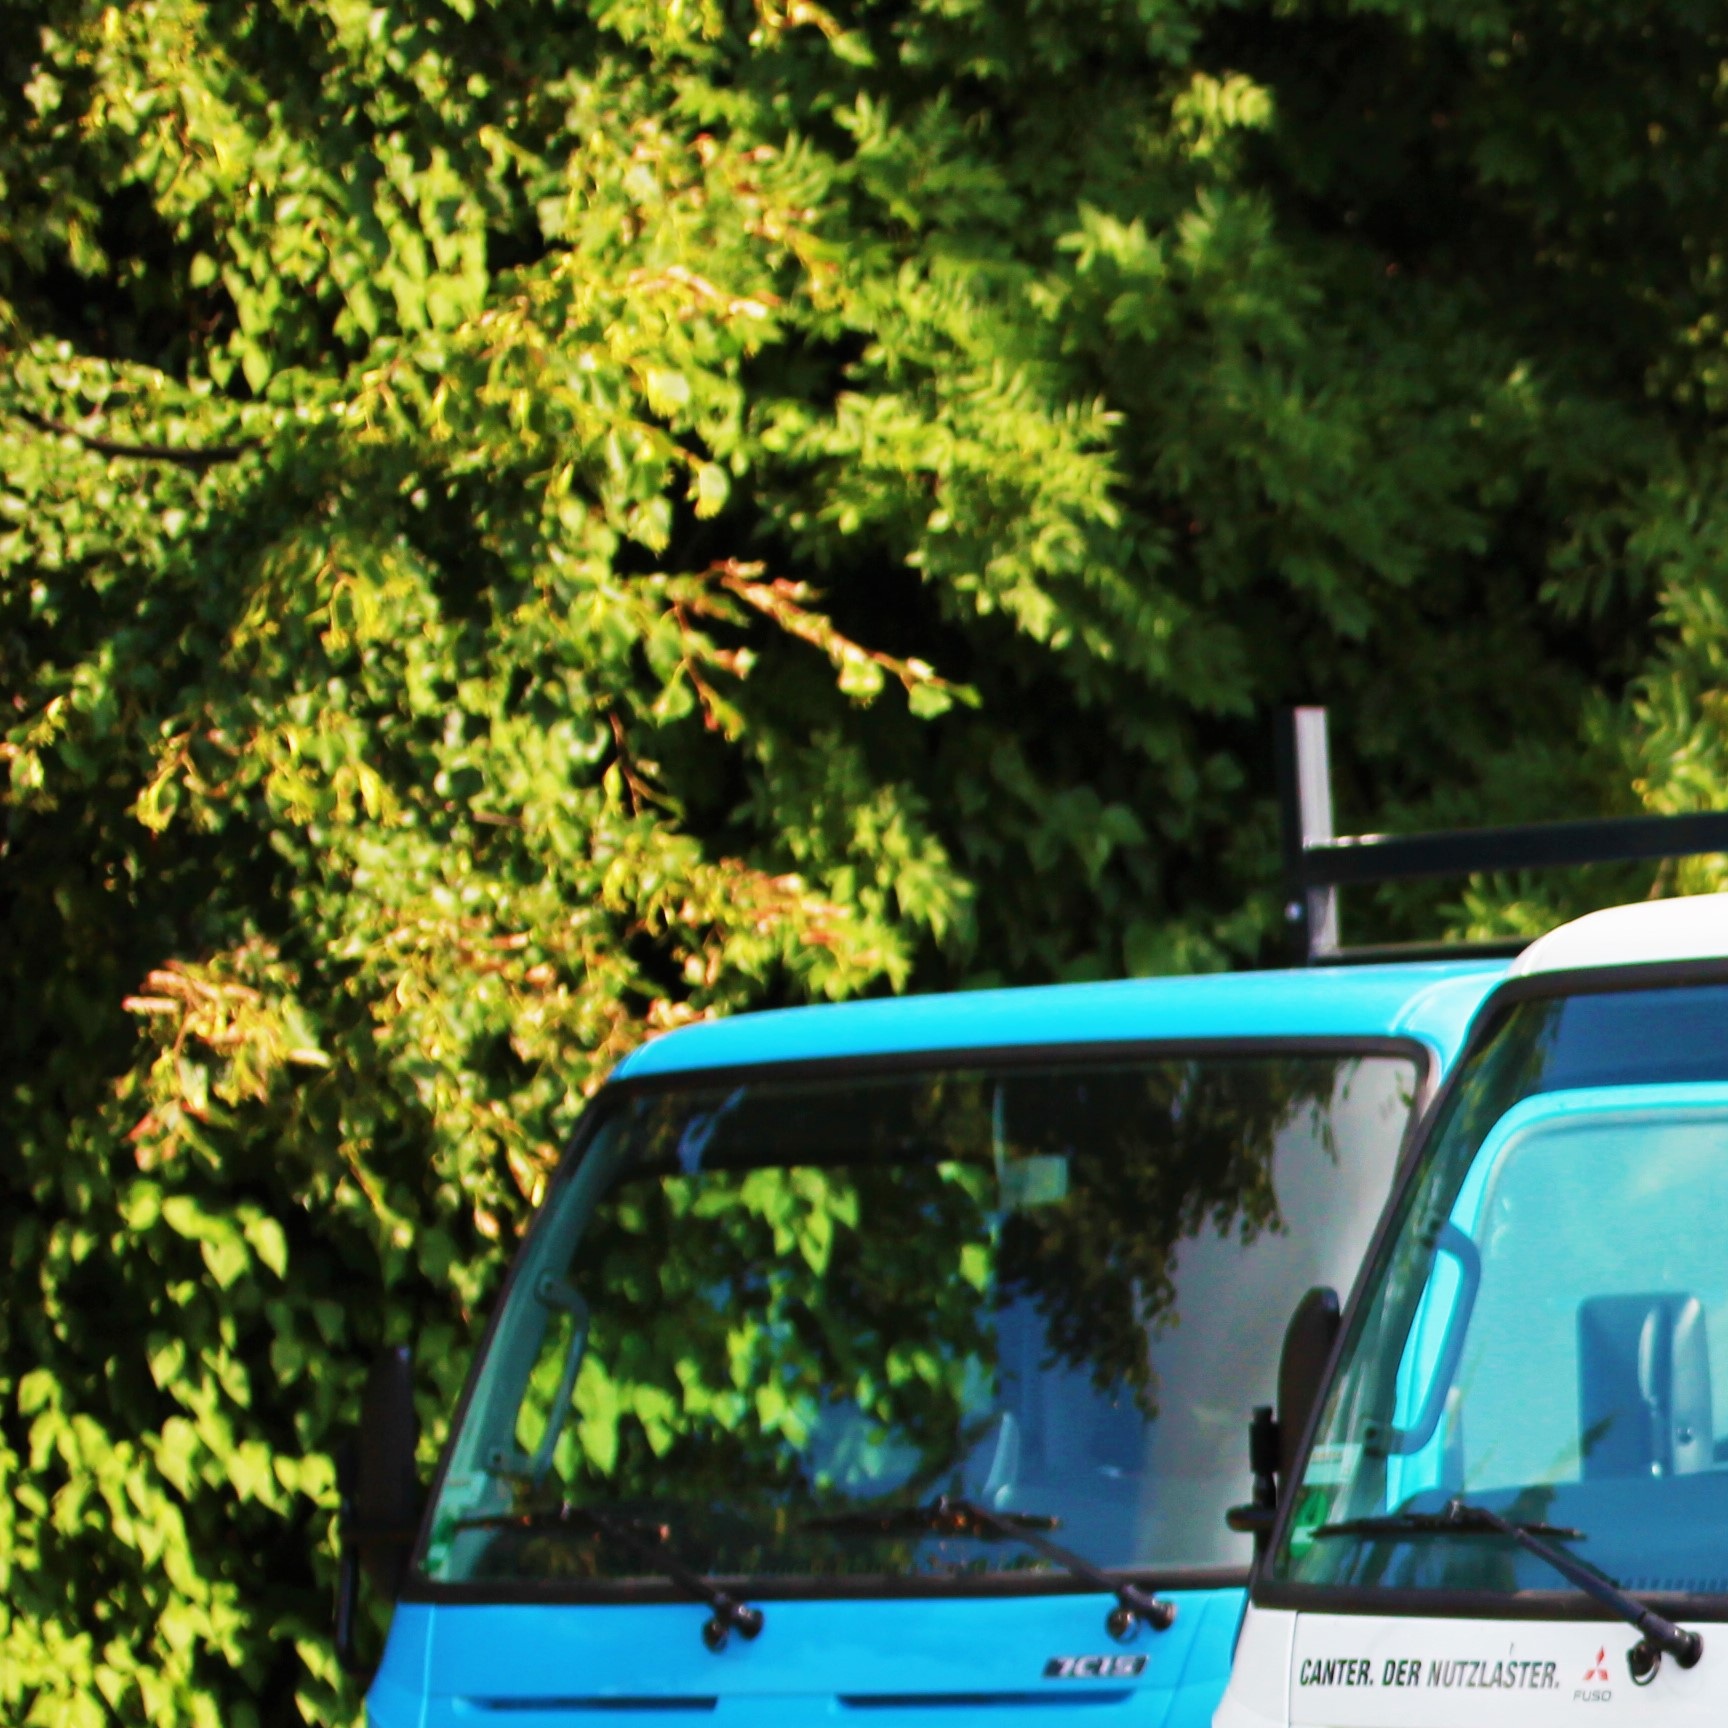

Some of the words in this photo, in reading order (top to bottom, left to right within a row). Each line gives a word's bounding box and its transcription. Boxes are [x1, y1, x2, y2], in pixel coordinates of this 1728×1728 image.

[1300, 1658, 1374, 1687] CANTER.
[1381, 1658, 1422, 1687] DER
[1427, 1660, 1560, 1689] NUTZLASTER.
[1572, 1690, 1613, 1702] FUSO
